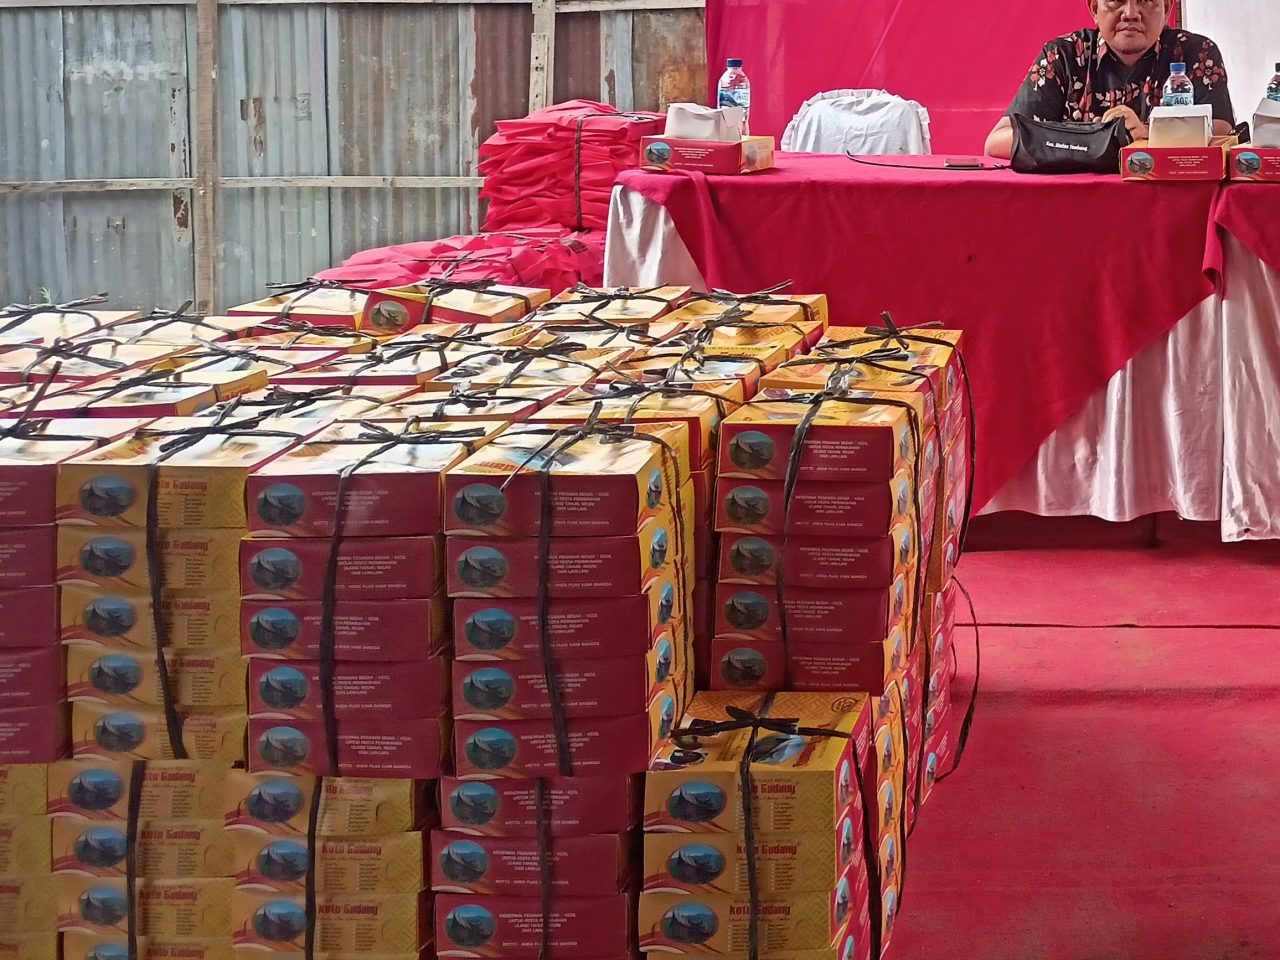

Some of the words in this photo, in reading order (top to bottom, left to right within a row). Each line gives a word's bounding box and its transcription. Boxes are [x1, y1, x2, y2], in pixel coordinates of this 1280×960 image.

[761, 784, 796, 795] Gadang
[321, 843, 345, 855] Koto
[347, 843, 382, 855] Gadang
[761, 844, 797, 856] Gadang
[343, 903, 379, 916] Gadang
